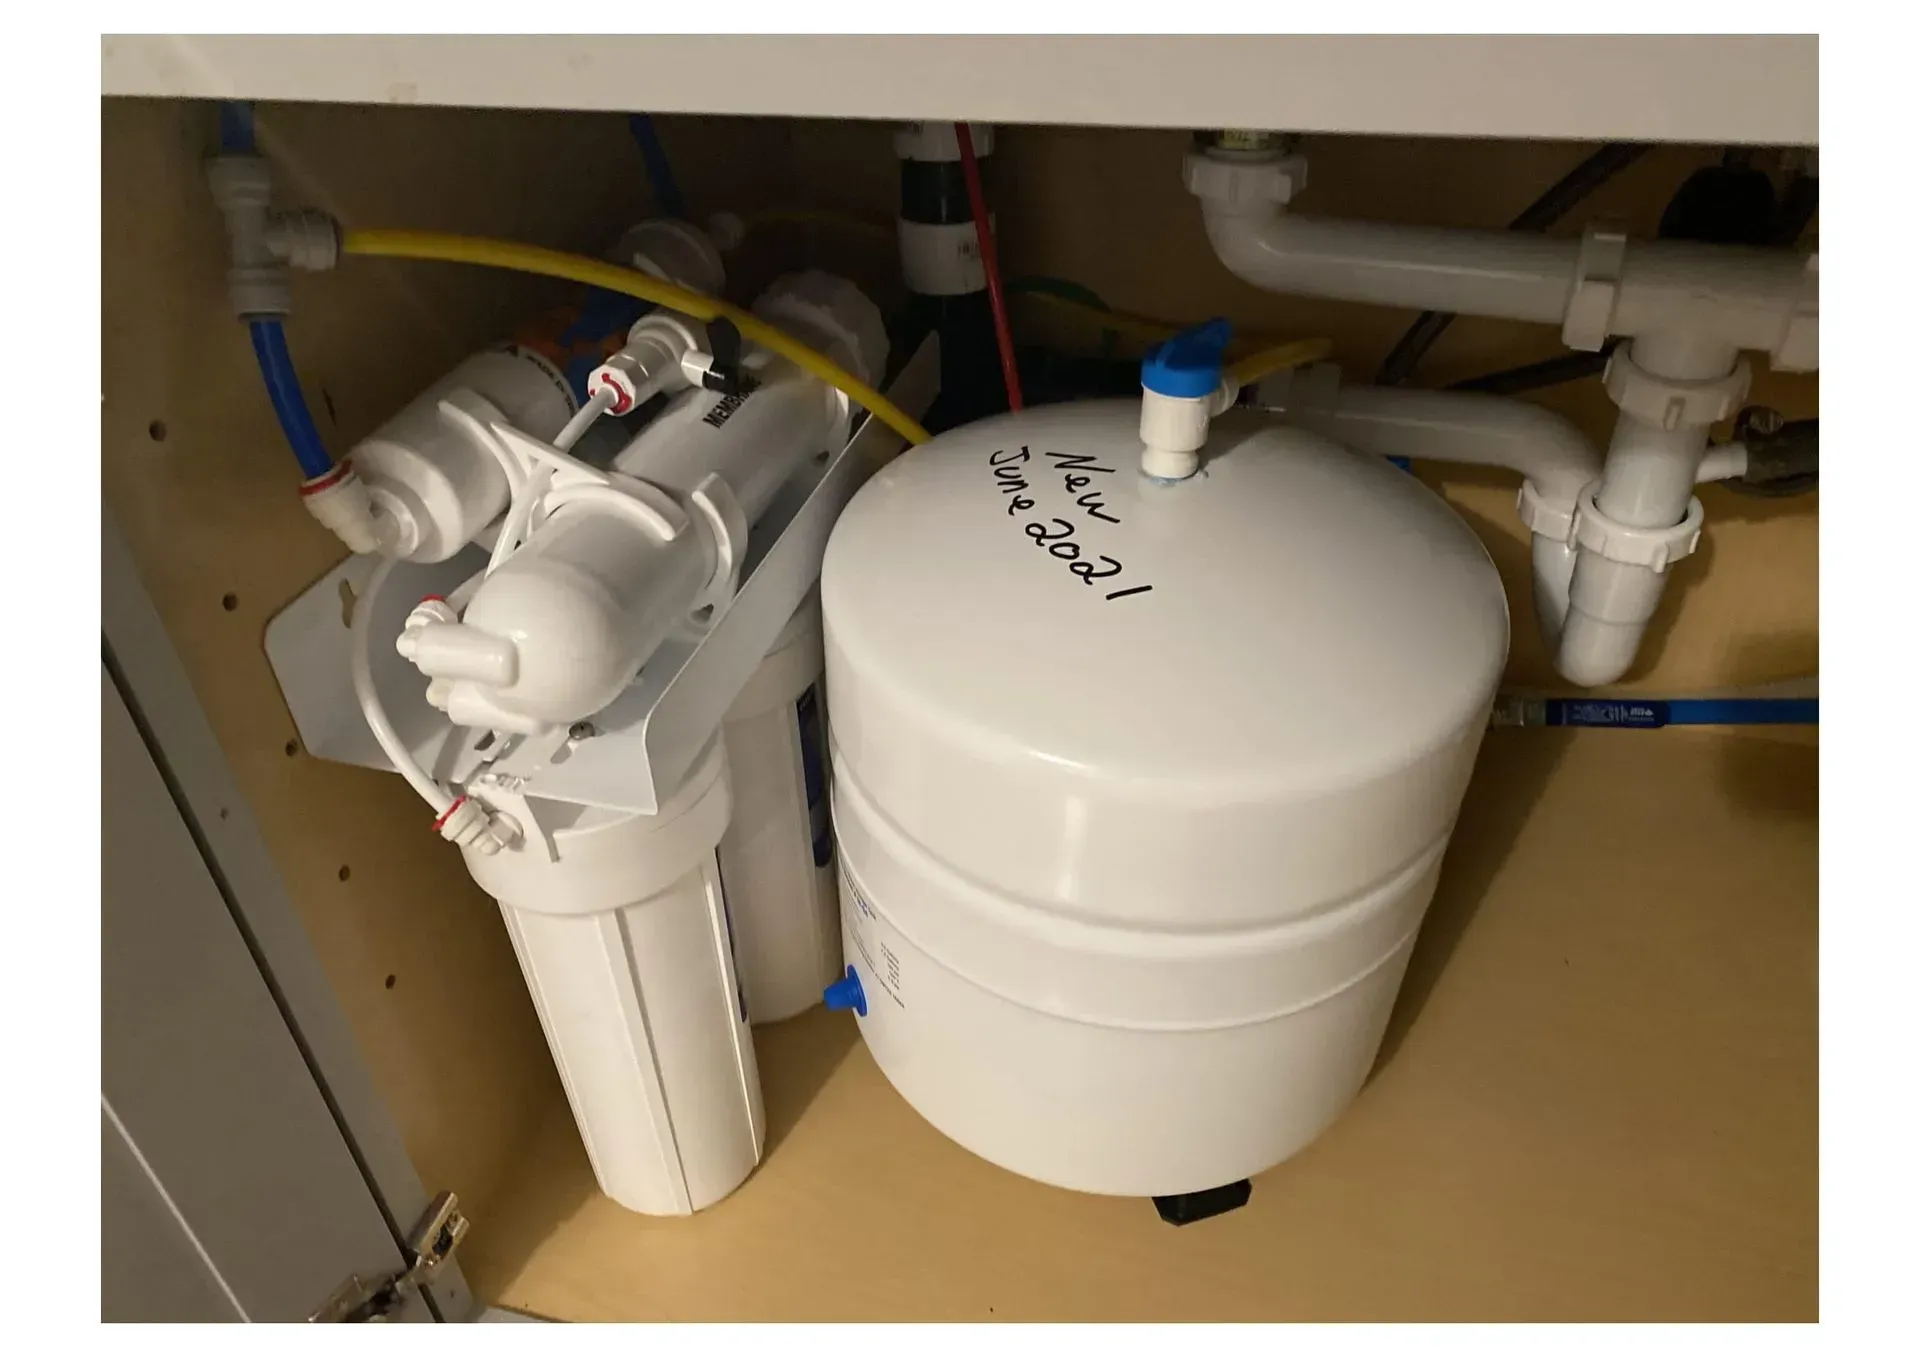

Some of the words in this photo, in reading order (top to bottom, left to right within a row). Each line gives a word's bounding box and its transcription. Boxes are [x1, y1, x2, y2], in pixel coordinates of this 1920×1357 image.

[989, 445, 1036, 516] June
[1025, 518, 1153, 601] 2021
[1045, 452, 1121, 524] New
